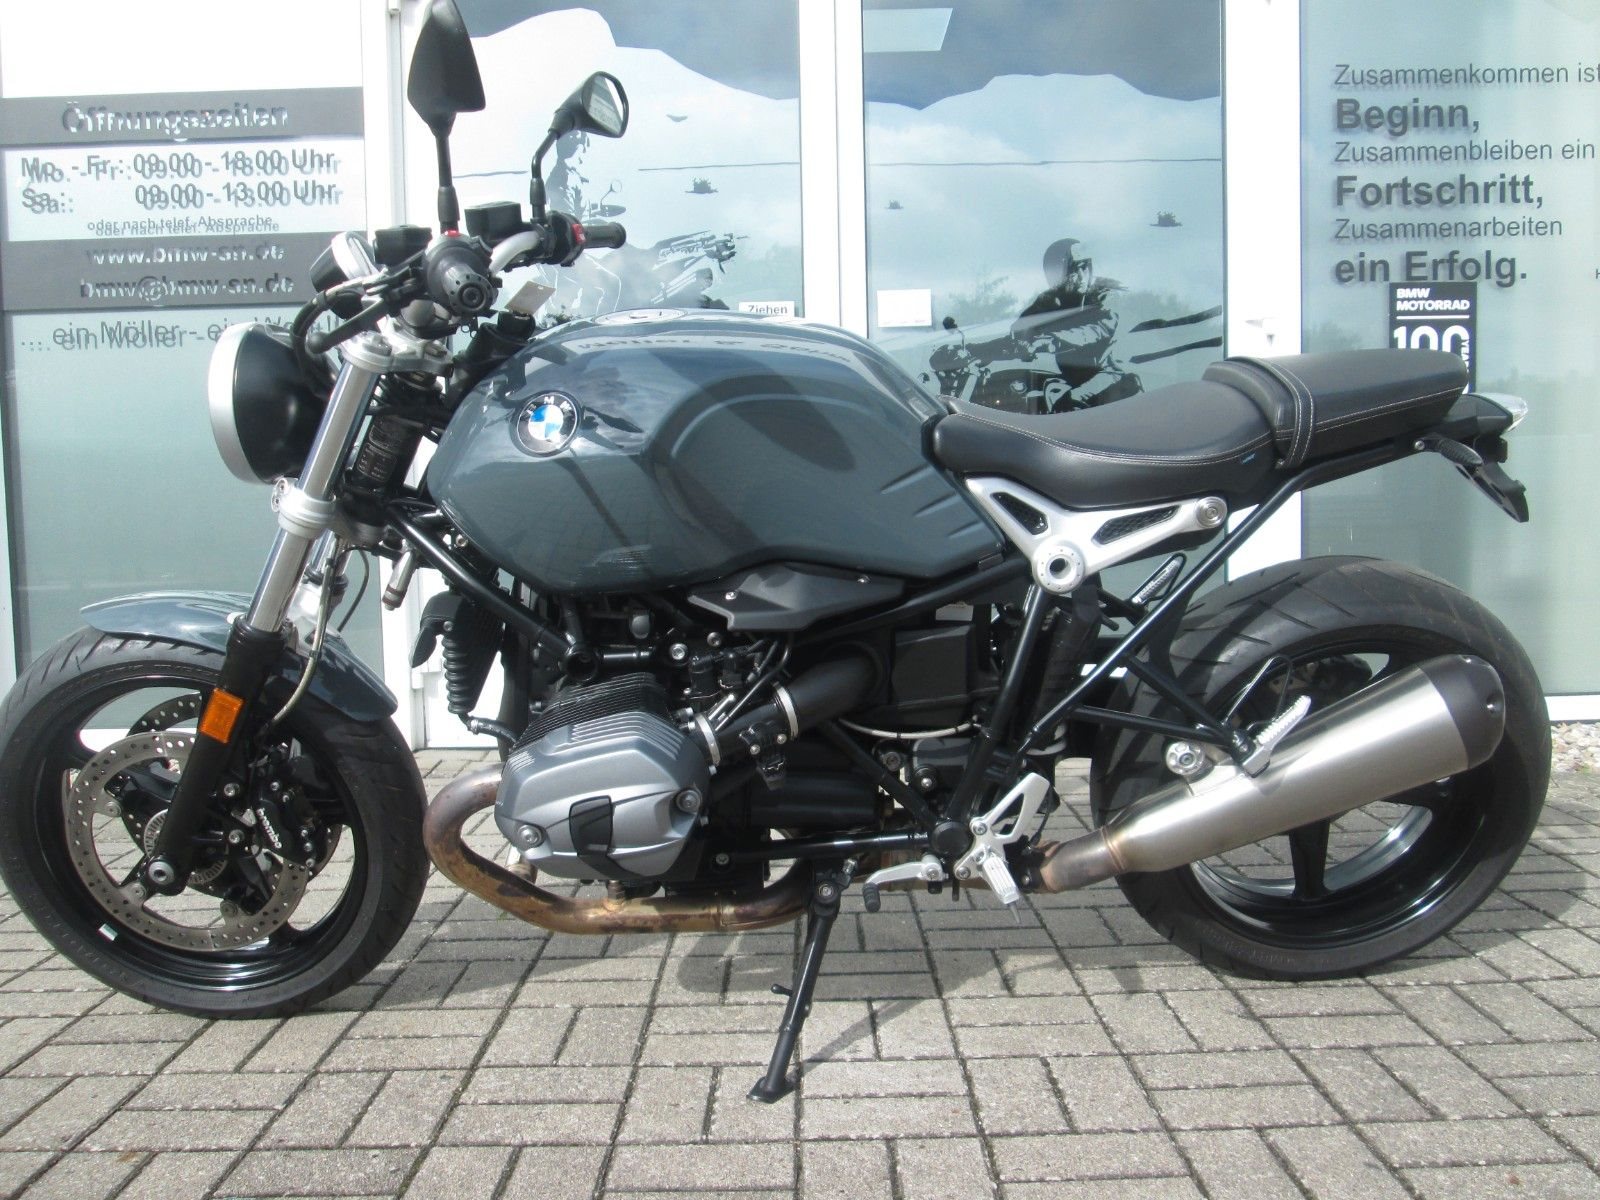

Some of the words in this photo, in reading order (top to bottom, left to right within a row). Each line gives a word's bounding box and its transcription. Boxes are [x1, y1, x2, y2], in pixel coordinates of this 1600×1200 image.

[1334, 63, 1568, 85] Zusammenkommen
[62, 101, 288, 141] Öffnungszeiten
[1336, 98, 1480, 137] Beginn,
[292, 149, 338, 173] Uhr
[1334, 139, 1552, 162] Zusammenbleiben
[1561, 139, 1595, 160] ein
[294, 180, 339, 203] Uhr
[1336, 173, 1543, 208] Fortschritt,
[88, 219, 121, 234] oder
[123, 218, 159, 233] nach
[199, 215, 276, 234] Absprache
[1334, 216, 1562, 239] Zusammenarbeiten
[1335, 252, 1390, 282] ein
[1405, 250, 1527, 287] Erfolg.
[1396, 288, 1430, 299] BMW
[1396, 299, 1470, 311] MOTORRAD
[748, 304, 788, 315] Ziehen
[101, 320, 184, 348] Möller
